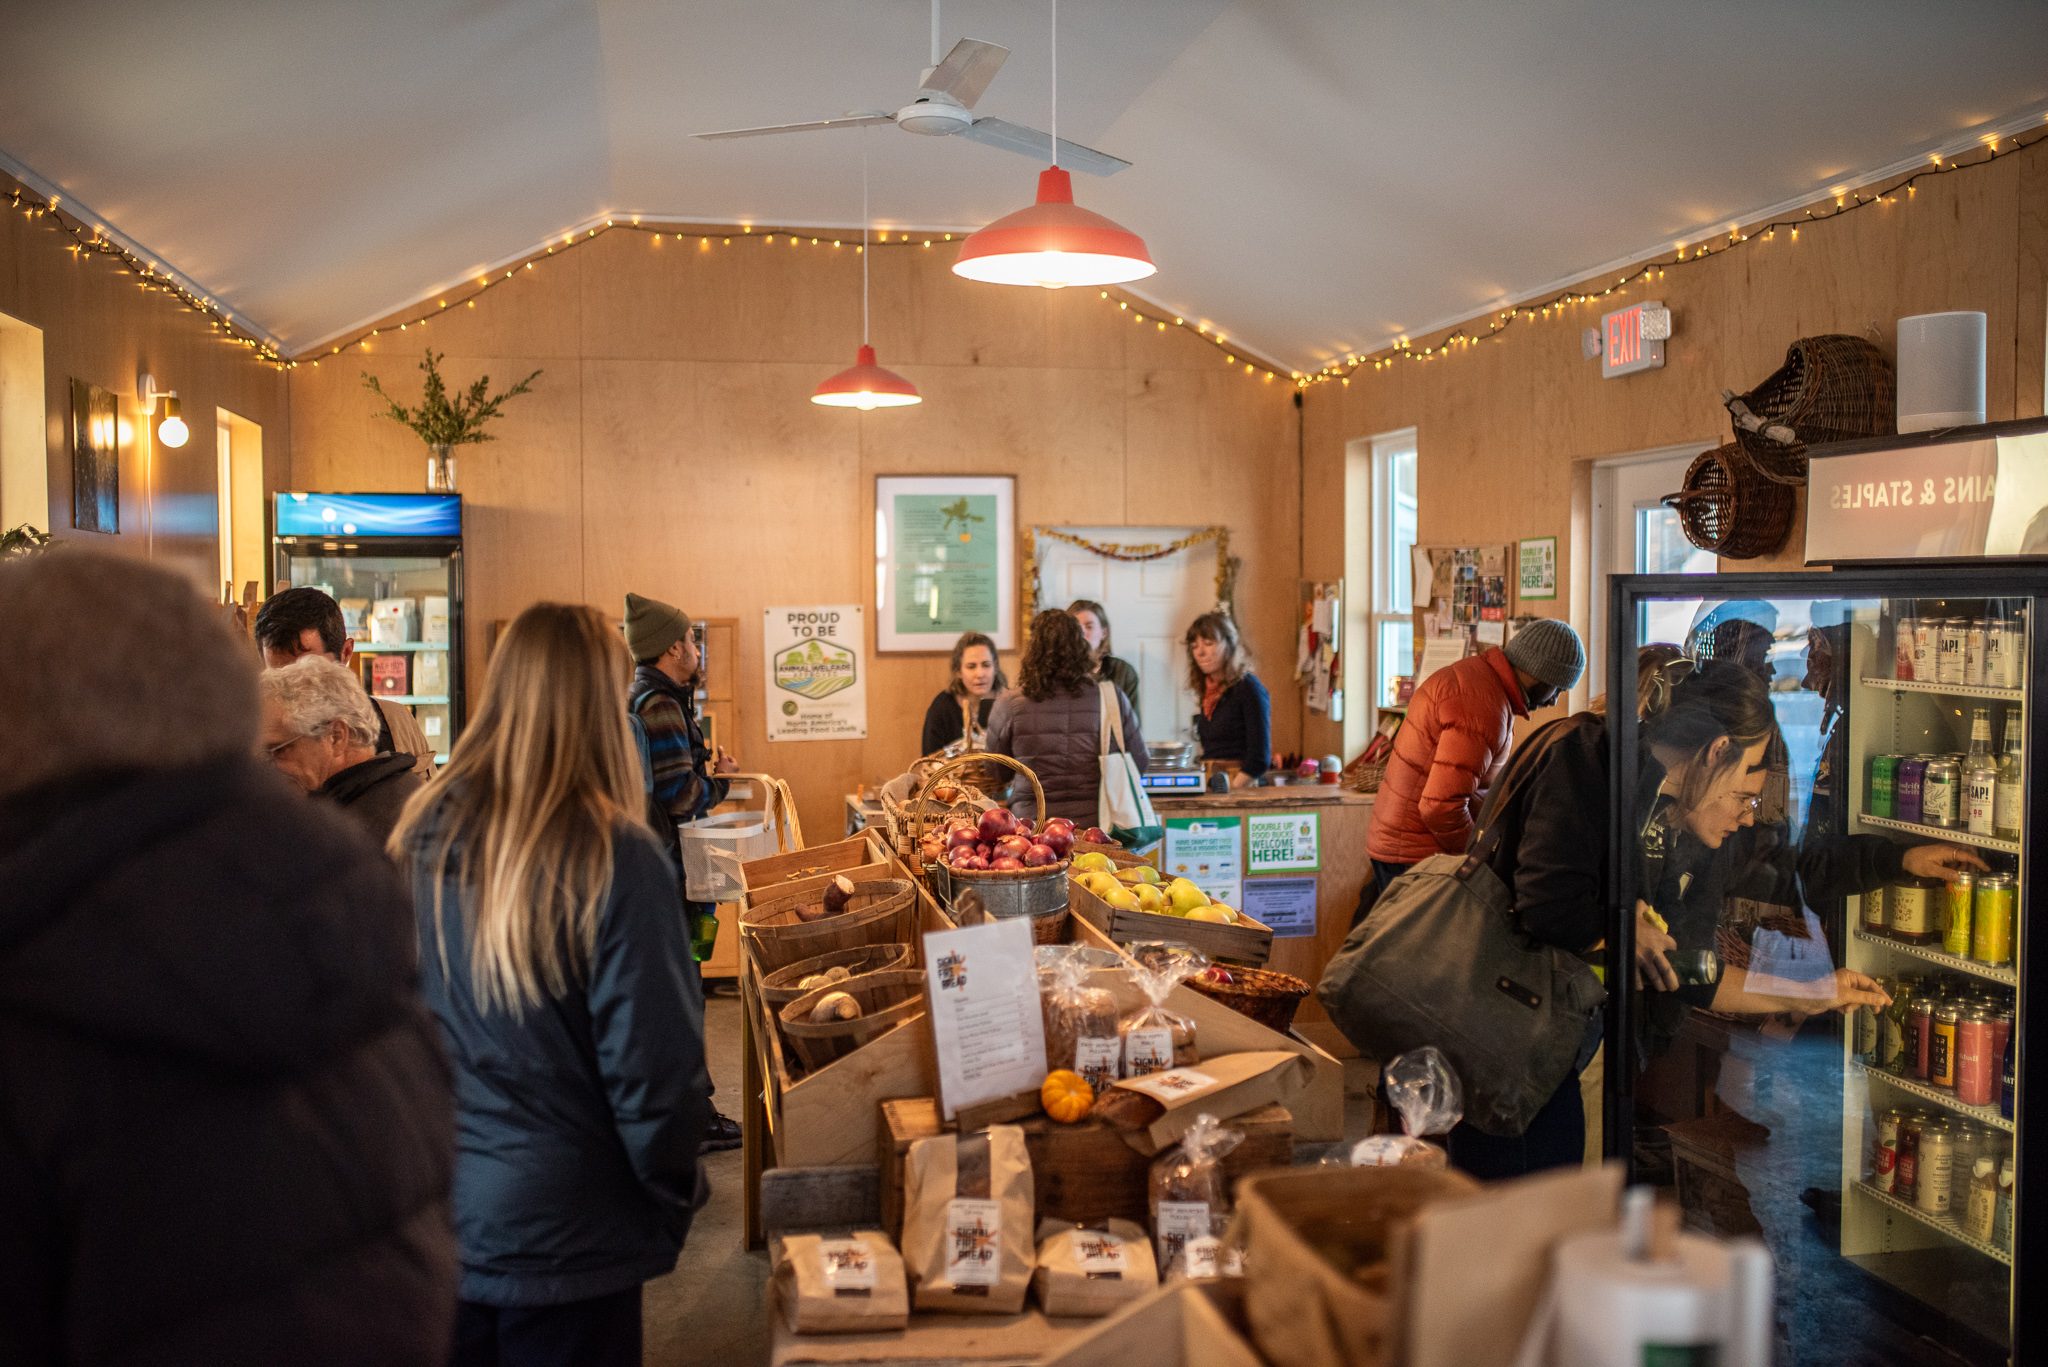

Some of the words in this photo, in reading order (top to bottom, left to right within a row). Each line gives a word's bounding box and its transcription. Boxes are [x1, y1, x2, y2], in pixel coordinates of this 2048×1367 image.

[1608, 306, 1643, 367] EXIT
[1521, 565, 1543, 576] WELCOME
[1521, 575, 1543, 589] HERE!
[787, 612, 840, 624] PROUD
[792, 626, 812, 637] TO
[818, 626, 836, 636] BE
[1970, 785, 1989, 800] SAP!
[1252, 823, 1281, 831] DOUBLE
[1283, 821, 1294, 830] UP
[1252, 838, 1293, 849] WELCOME
[1252, 848, 1294, 862] HERE!
[1134, 1057, 1163, 1067] SIGNAL
